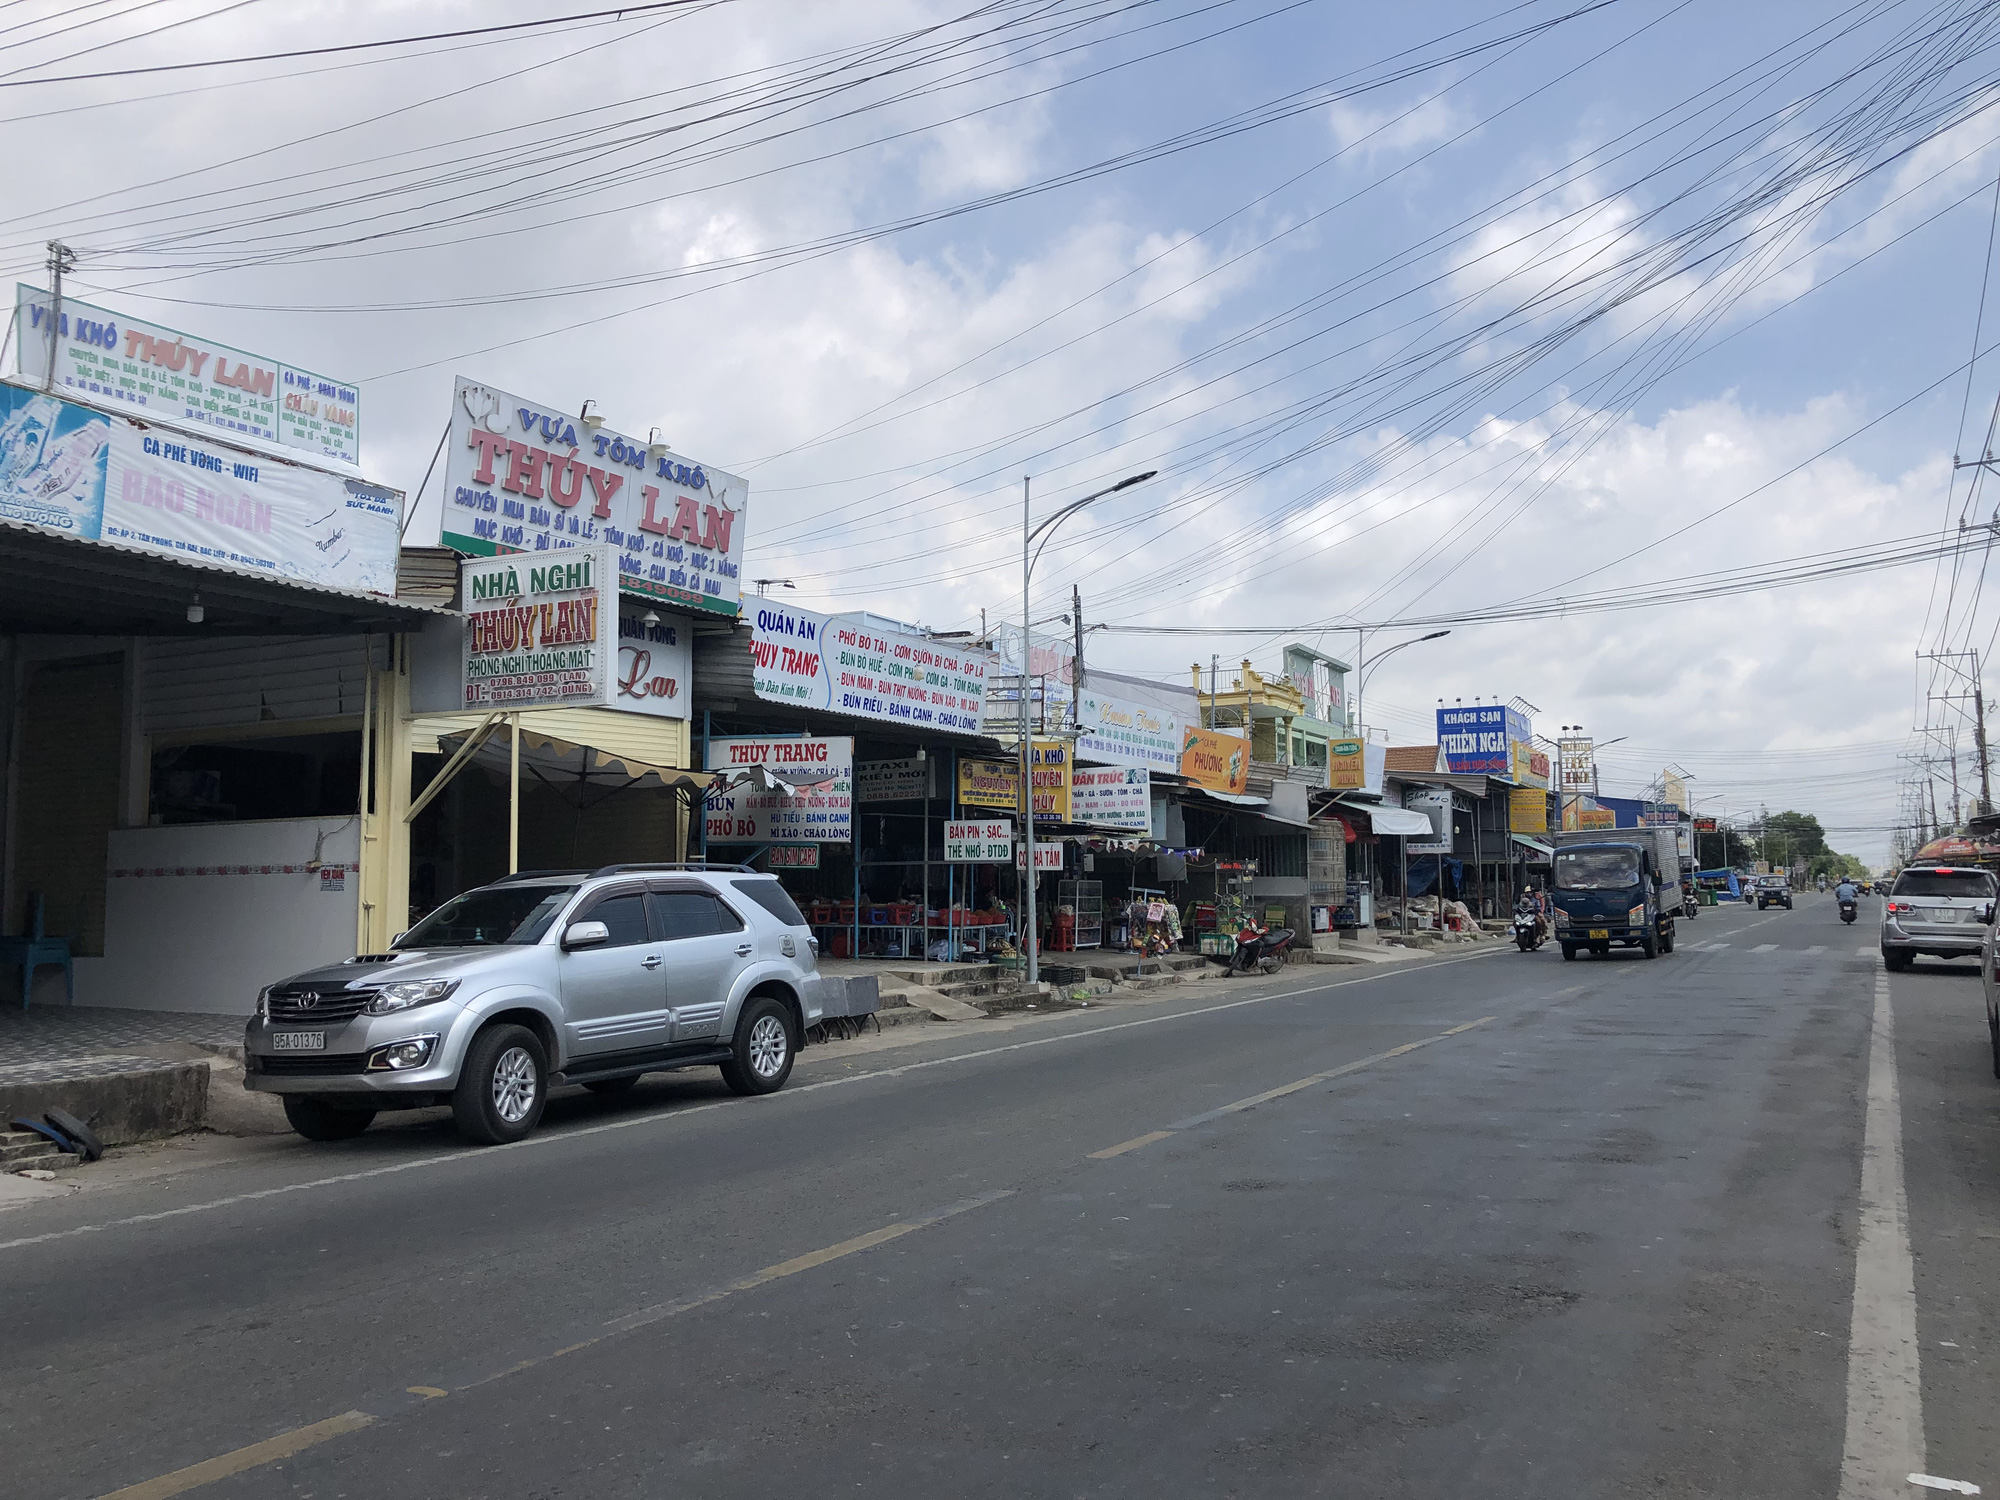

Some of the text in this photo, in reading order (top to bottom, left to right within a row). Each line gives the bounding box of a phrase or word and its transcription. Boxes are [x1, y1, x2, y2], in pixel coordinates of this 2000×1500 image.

[74, 317, 117, 350] KHÔ
[124, 330, 210, 377] THÚY
[213, 357, 275, 397] LAN
[103, 356, 119, 371] MUA
[123, 361, 138, 375] BÁN
[143, 437, 160, 457] CÀ
[163, 442, 187, 464] PHÊ
[233, 462, 259, 483] WIFI
[517, 408, 705, 489] VỰA TÔM KHÔ
[122, 467, 272, 534] BẢO NGÂN
[468, 428, 735, 553] THÚY LAN
[455, 486, 498, 513] CHUYÊN
[502, 499, 524, 521] MUA
[529, 506, 551, 528] BÁN
[568, 516, 579, 535] VÀ
[603, 525, 624, 547] TÔM
[626, 534, 645, 552] KHÔ
[652, 540, 664, 558] CÁ
[665, 544, 684, 563] KHÔ
[709, 558, 715, 573] 1
[717, 556, 738, 578] NẮNG
[472, 517, 497, 541] MỰC
[500, 525, 524, 547] KHÔ
[649, 563, 666, 582] CUA
[690, 573, 700, 590] CÀ
[703, 578, 721, 596] MAU
[472, 554, 594, 599] NHÀ NGHỈ
[469, 597, 597, 653] THÚY LAN
[619, 616, 646, 640] UÁN
[758, 609, 816, 641] QUÁN ĂN
[468, 644, 592, 677] PHÒNG NGHỈ THOÁNG MÁT
[781, 646, 819, 678] TRANG
[838, 628, 857, 647] PHỞ
[858, 633, 871, 650] BÒ
[874, 636, 888, 654] TÁI
[894, 644, 911, 660] CƠM
[913, 648, 933, 666] SƯỜN
[934, 653, 942, 668] BÌ
[944, 655, 958, 672] CHẢ
[964, 658, 974, 675] ỐP
[490, 671, 587, 687] 0796.849 099 (LAN)
[618, 646, 679, 699] Lan
[840, 649, 983, 696] BÚN BÒ HUẾ CƠM CƠM GÀ TÔM RANG
[466, 684, 486, 702] ĐT:
[491, 688, 532, 700] 0914.314
[536, 686, 553, 697] 742
[765, 679, 779, 694] Dân
[780, 682, 795, 696] Kính
[841, 670, 979, 713] BÚN MẮM BÚN THỊT NƯỚNG BÚN XÀO MÌ XÀO
[843, 691, 977, 730] BÚN RIÊU BÁNH CANH CHÁO LÒNG
[1444, 710, 1477, 724] KHÁCH
[1480, 711, 1501, 725] SẠN
[730, 741, 828, 763] THÙY TRANG
[1441, 728, 1506, 754] THIÊN NGA
[1045, 744, 1064, 764] KHÔ
[1194, 752, 1223, 773] PHƯƠNG
[1097, 769, 1124, 785] TRÚC
[1088, 788, 1096, 797] GÀ
[1117, 787, 1129, 796] TÔM
[1407, 790, 1430, 802] Shop
[706, 813, 756, 837] PHỞ BÒ
[770, 810, 850, 823] HỦ TIẾU BÁNH CANH
[770, 826, 850, 838] MÌ XÀO CHÁO LÒNG
[949, 824, 980, 839] BÁN PIN
[786, 847, 816, 865] SIM CARD
[947, 840, 963, 858] THẺ
[965, 842, 981, 858] NHỚ
[1045, 845, 1060, 867] TẮM
